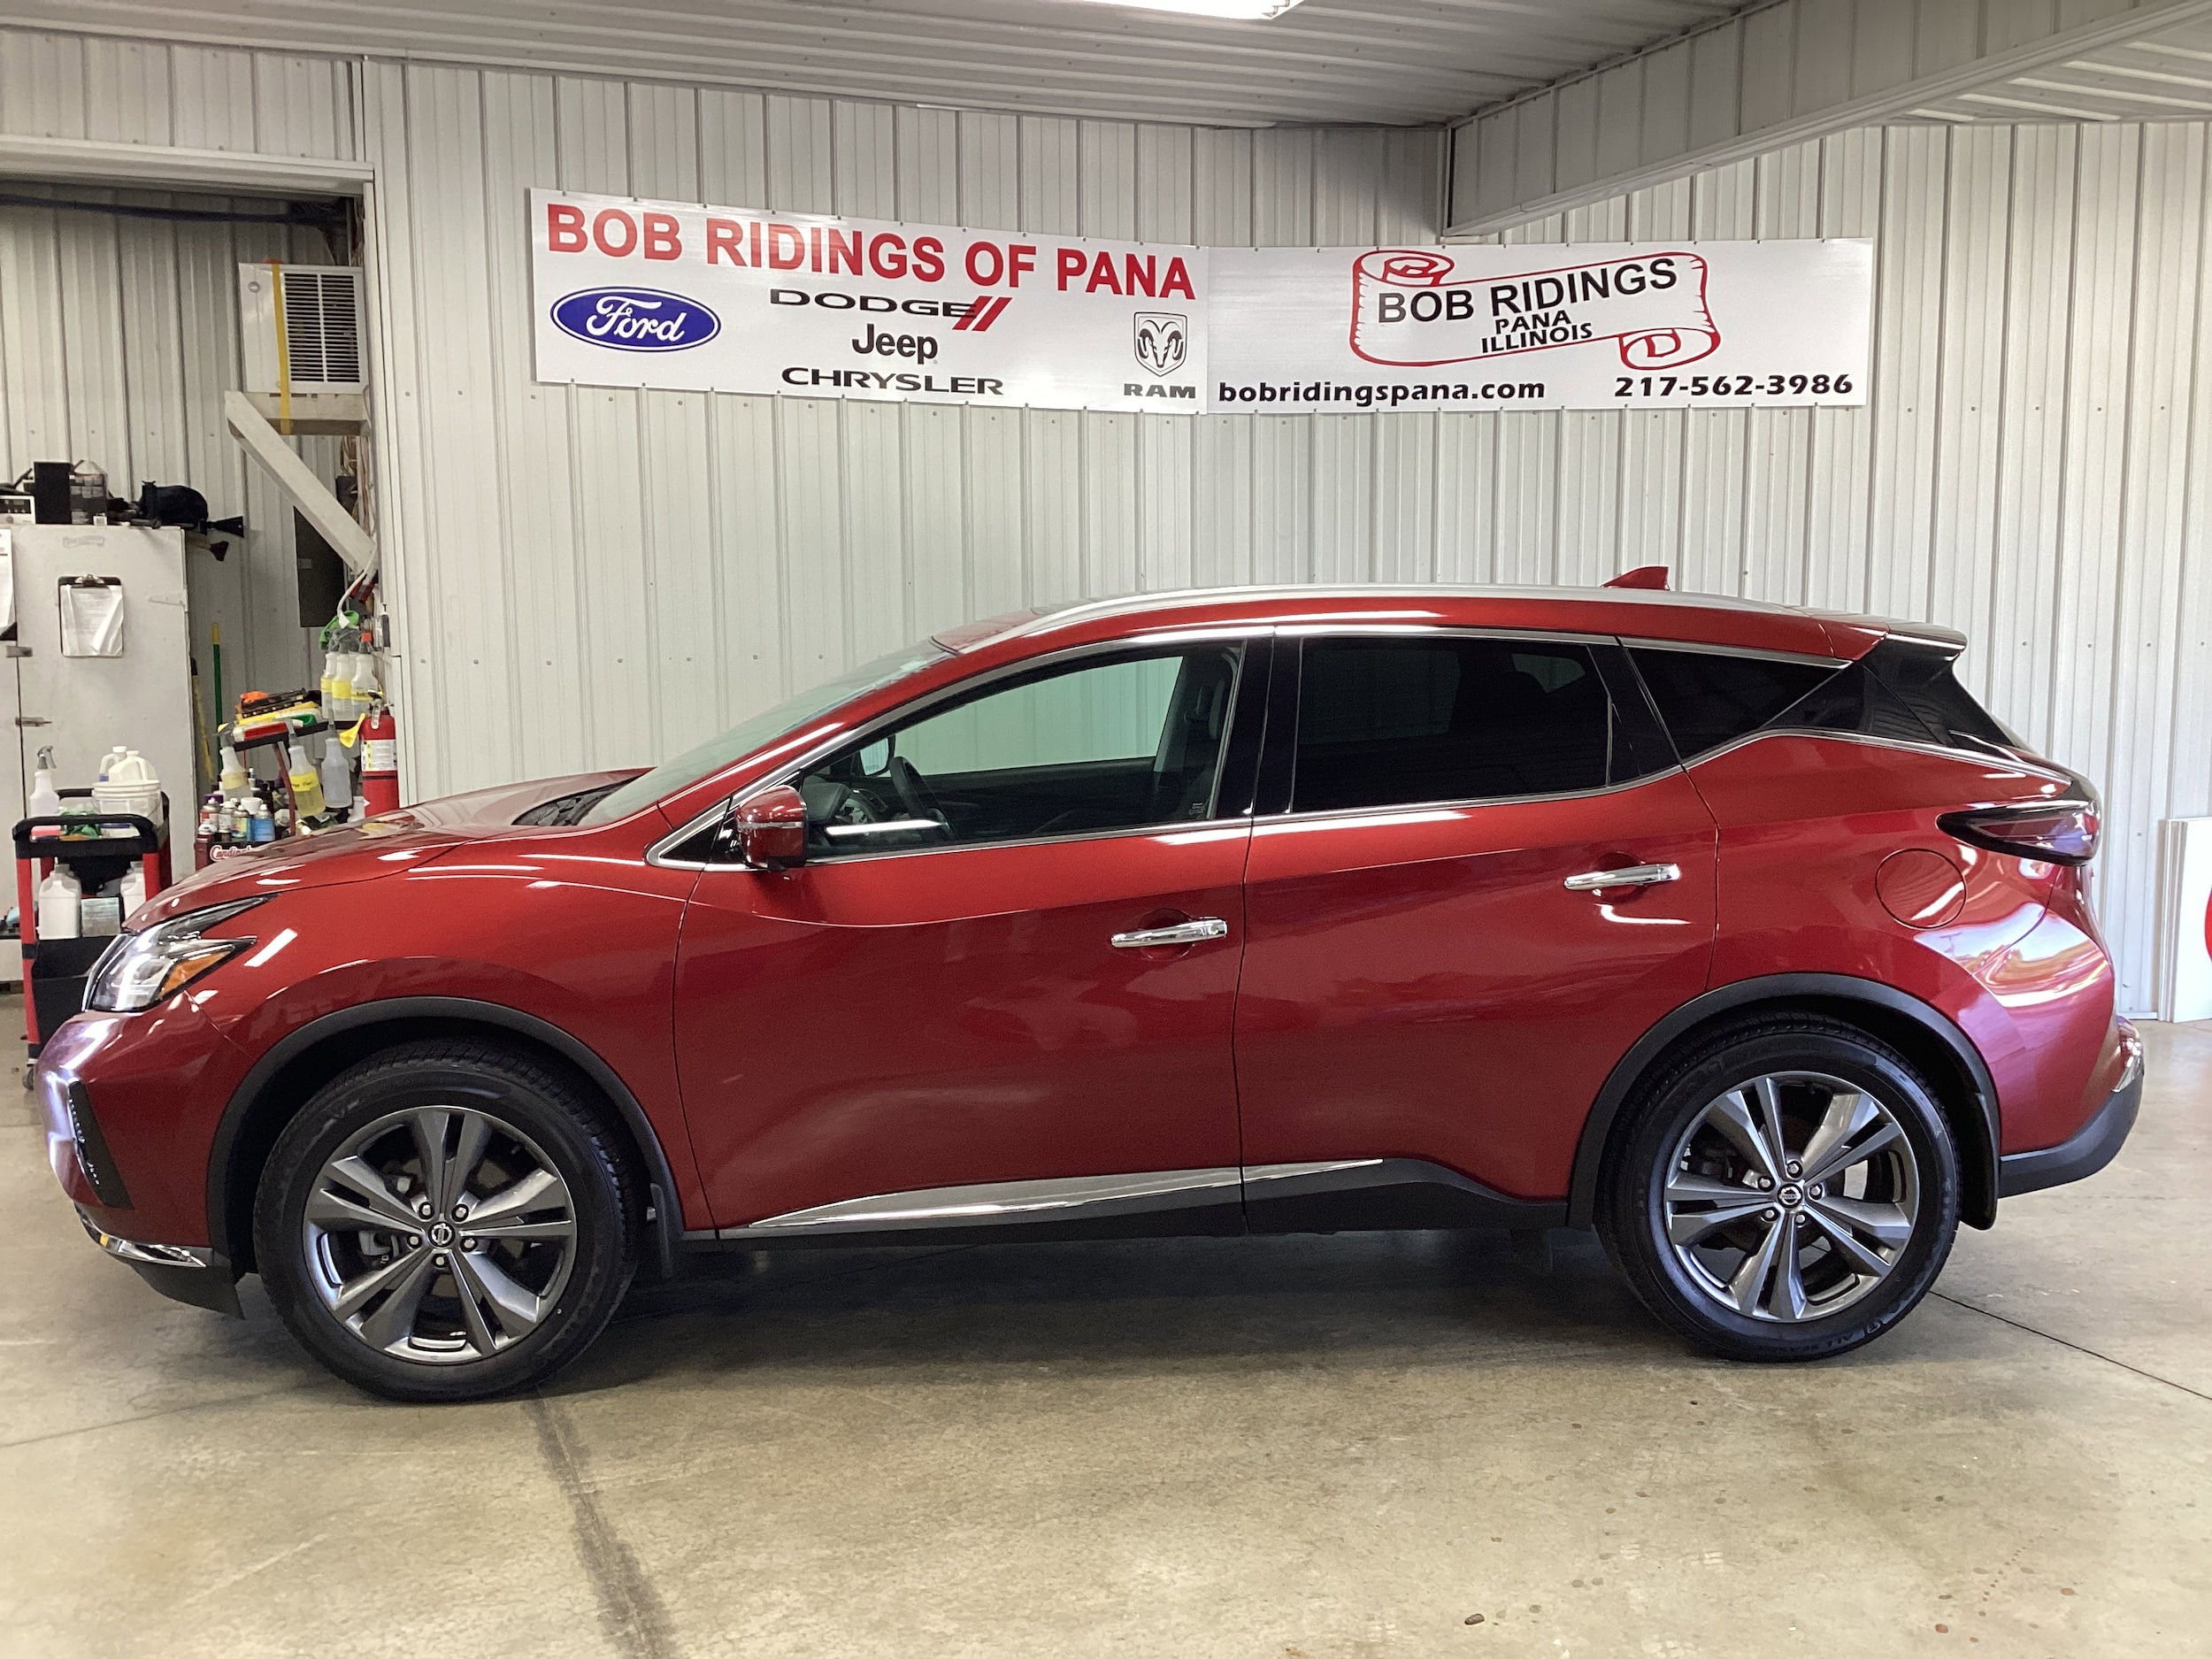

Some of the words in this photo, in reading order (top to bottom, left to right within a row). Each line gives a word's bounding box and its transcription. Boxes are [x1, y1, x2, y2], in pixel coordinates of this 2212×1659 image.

[547, 203, 682, 261] BOB
[706, 217, 945, 283] RIDINGS
[964, 241, 1037, 288] OF
[1056, 247, 1196, 300] PANA
[770, 288, 978, 318] DODGE
[1378, 289, 1474, 323] BOB
[1490, 257, 1678, 317] RIDINGS
[585, 295, 687, 343] Ford
[1494, 310, 1572, 334] PANA
[851, 323, 939, 365] Jeep
[1481, 322, 1594, 353] ILLINOIS
[780, 367, 1004, 396] CHRYSLER
[1124, 383, 1196, 398] RAM
[1218, 381, 1545, 407] bobridingspana.com
[1614, 374, 1853, 397] 217-562-3986
